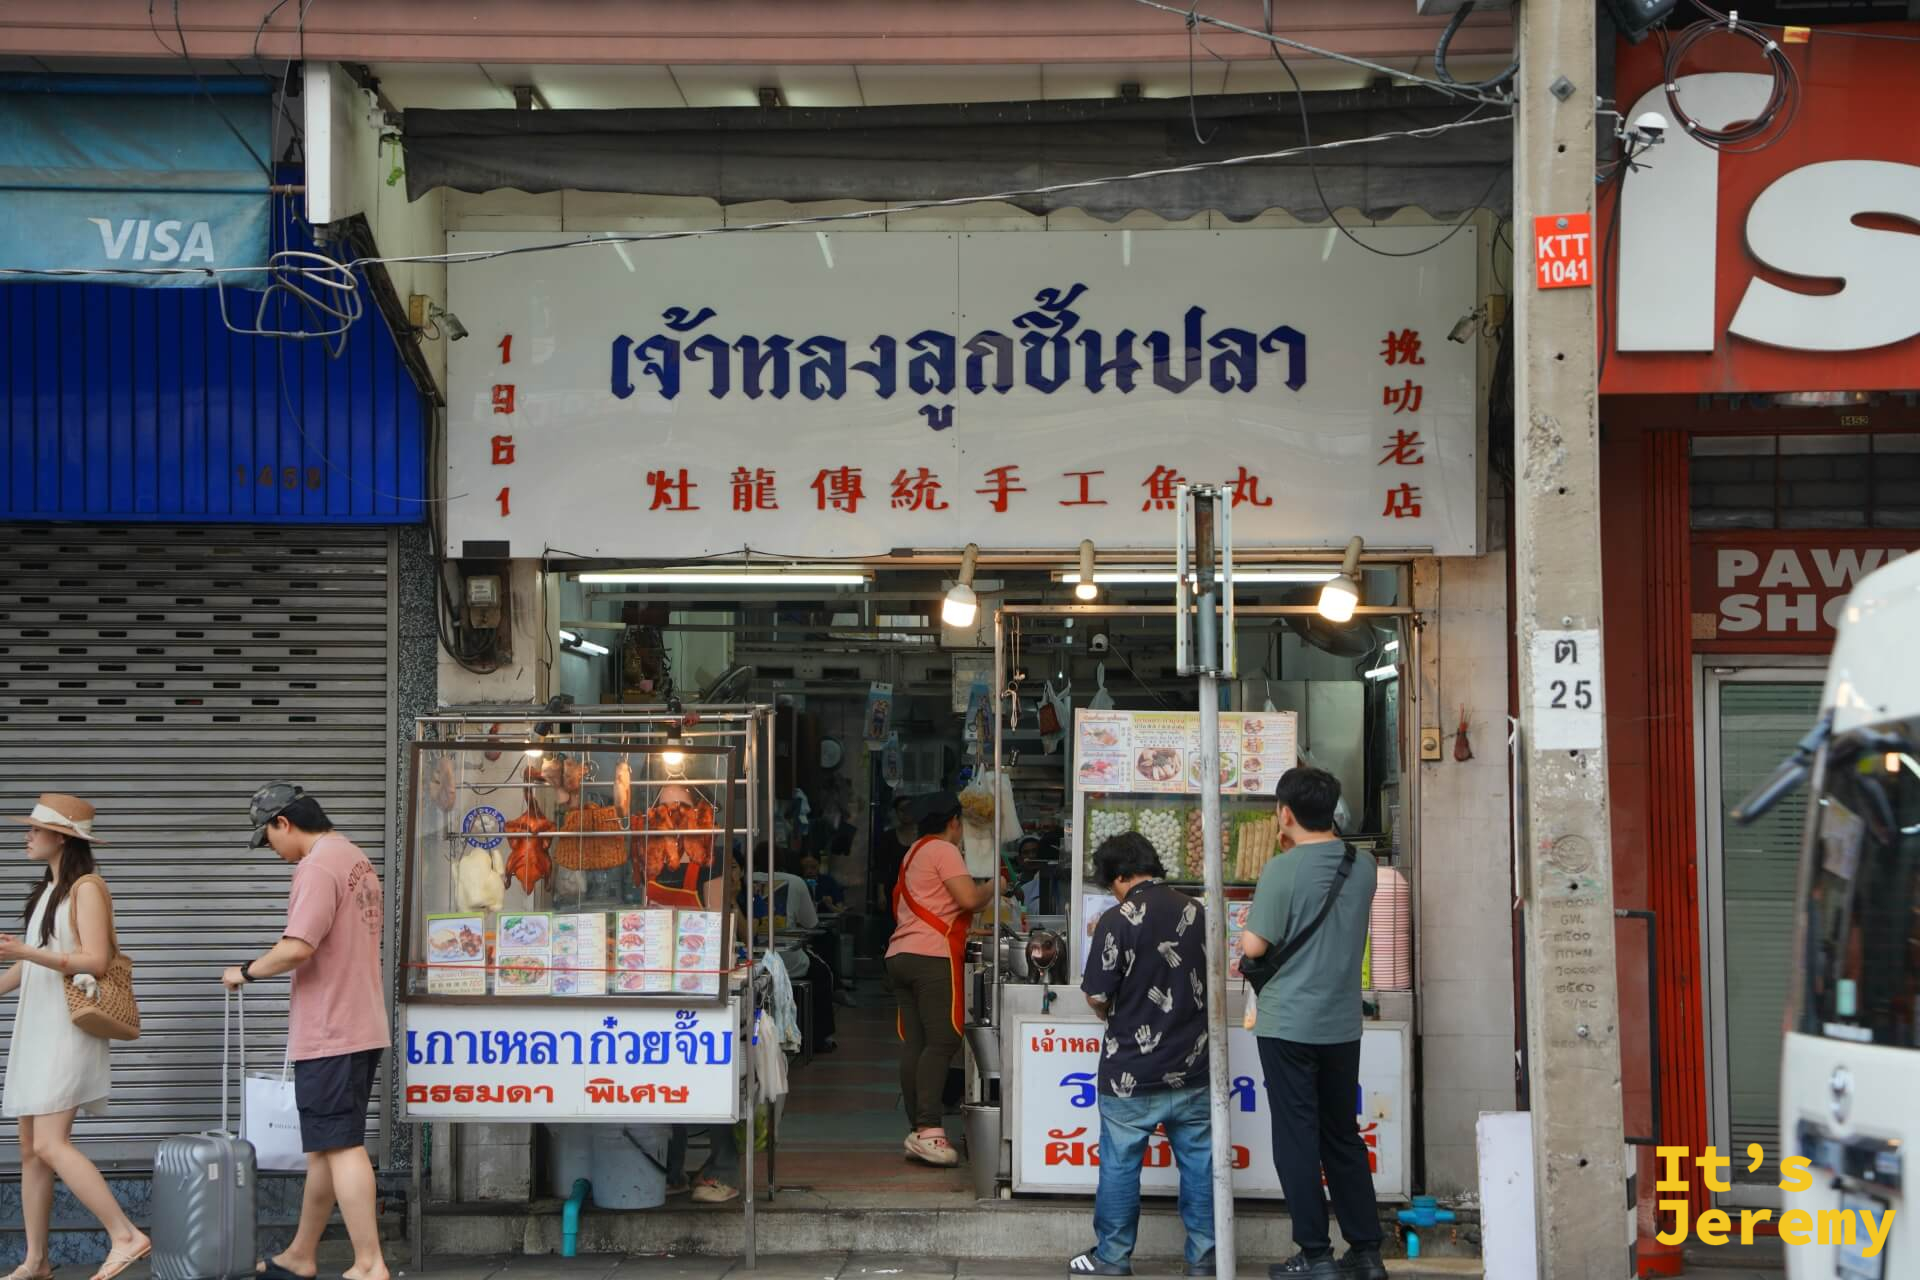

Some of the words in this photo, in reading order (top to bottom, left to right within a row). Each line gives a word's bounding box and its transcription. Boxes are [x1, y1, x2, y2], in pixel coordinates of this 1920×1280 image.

[88, 216, 215, 264] VISA
[1538, 233, 1589, 259] KTT
[1539, 258, 1589, 284] 1041
[611, 283, 1308, 431] เจ้าหลงลูกชิ้นปลา
[1379, 329, 1425, 519] 挽叻老店
[1550, 679, 1592, 710] 25
[406, 1009, 735, 1068] เกาเหลาก๋วยจั๊บ
[406, 1083, 555, 1104] ธรรมดา
[584, 1077, 690, 1105] พิเศษ
